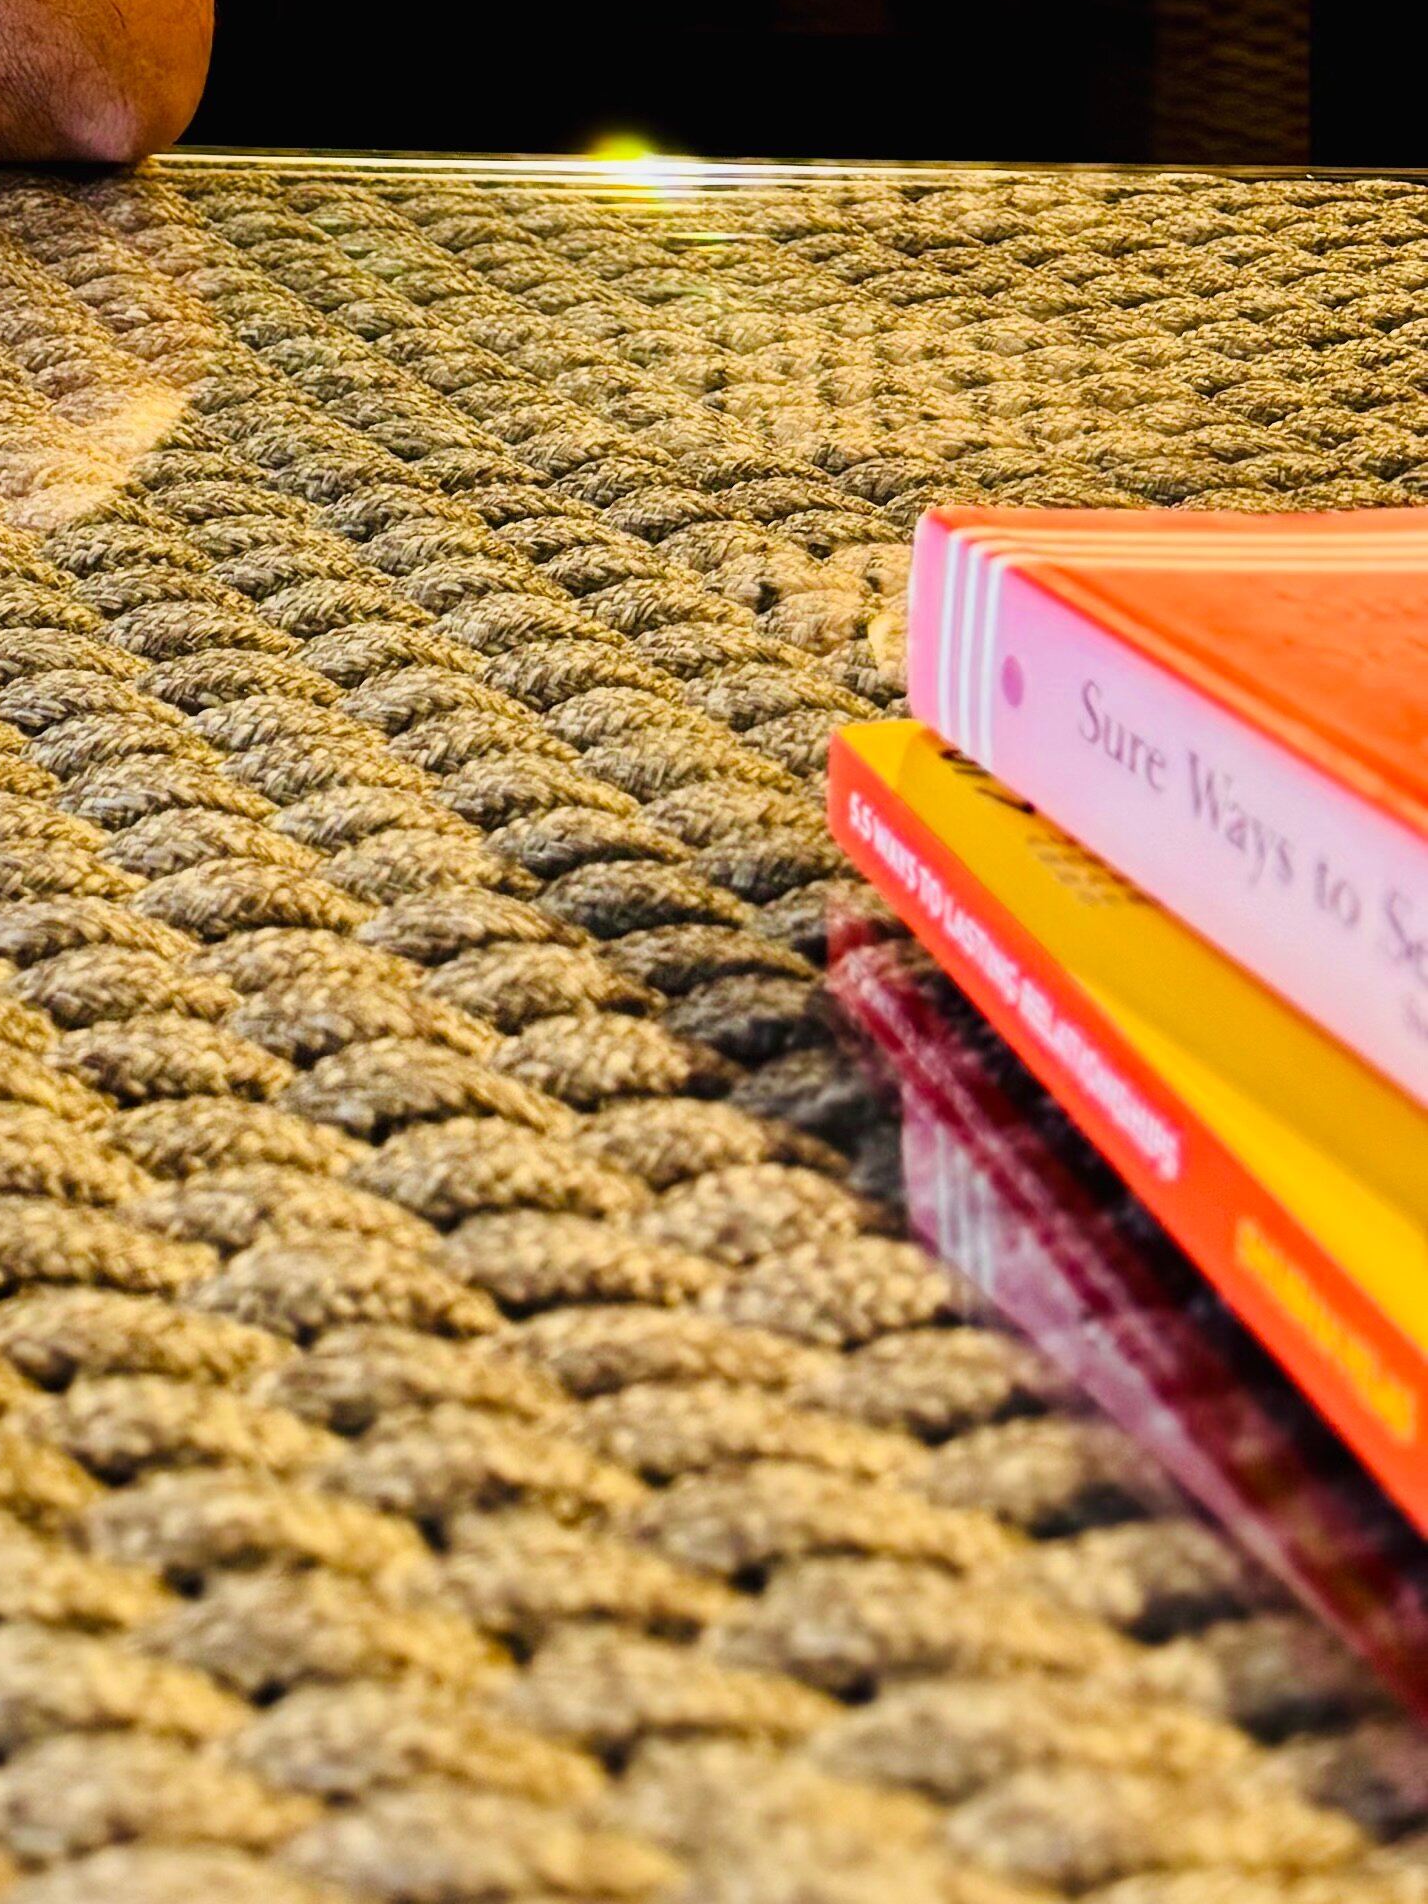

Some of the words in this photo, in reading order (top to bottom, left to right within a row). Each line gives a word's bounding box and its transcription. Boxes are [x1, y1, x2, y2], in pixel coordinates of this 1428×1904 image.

[1080, 678, 1167, 794] Sure
[1186, 748, 1295, 888] Ways
[1314, 860, 1361, 930] to
